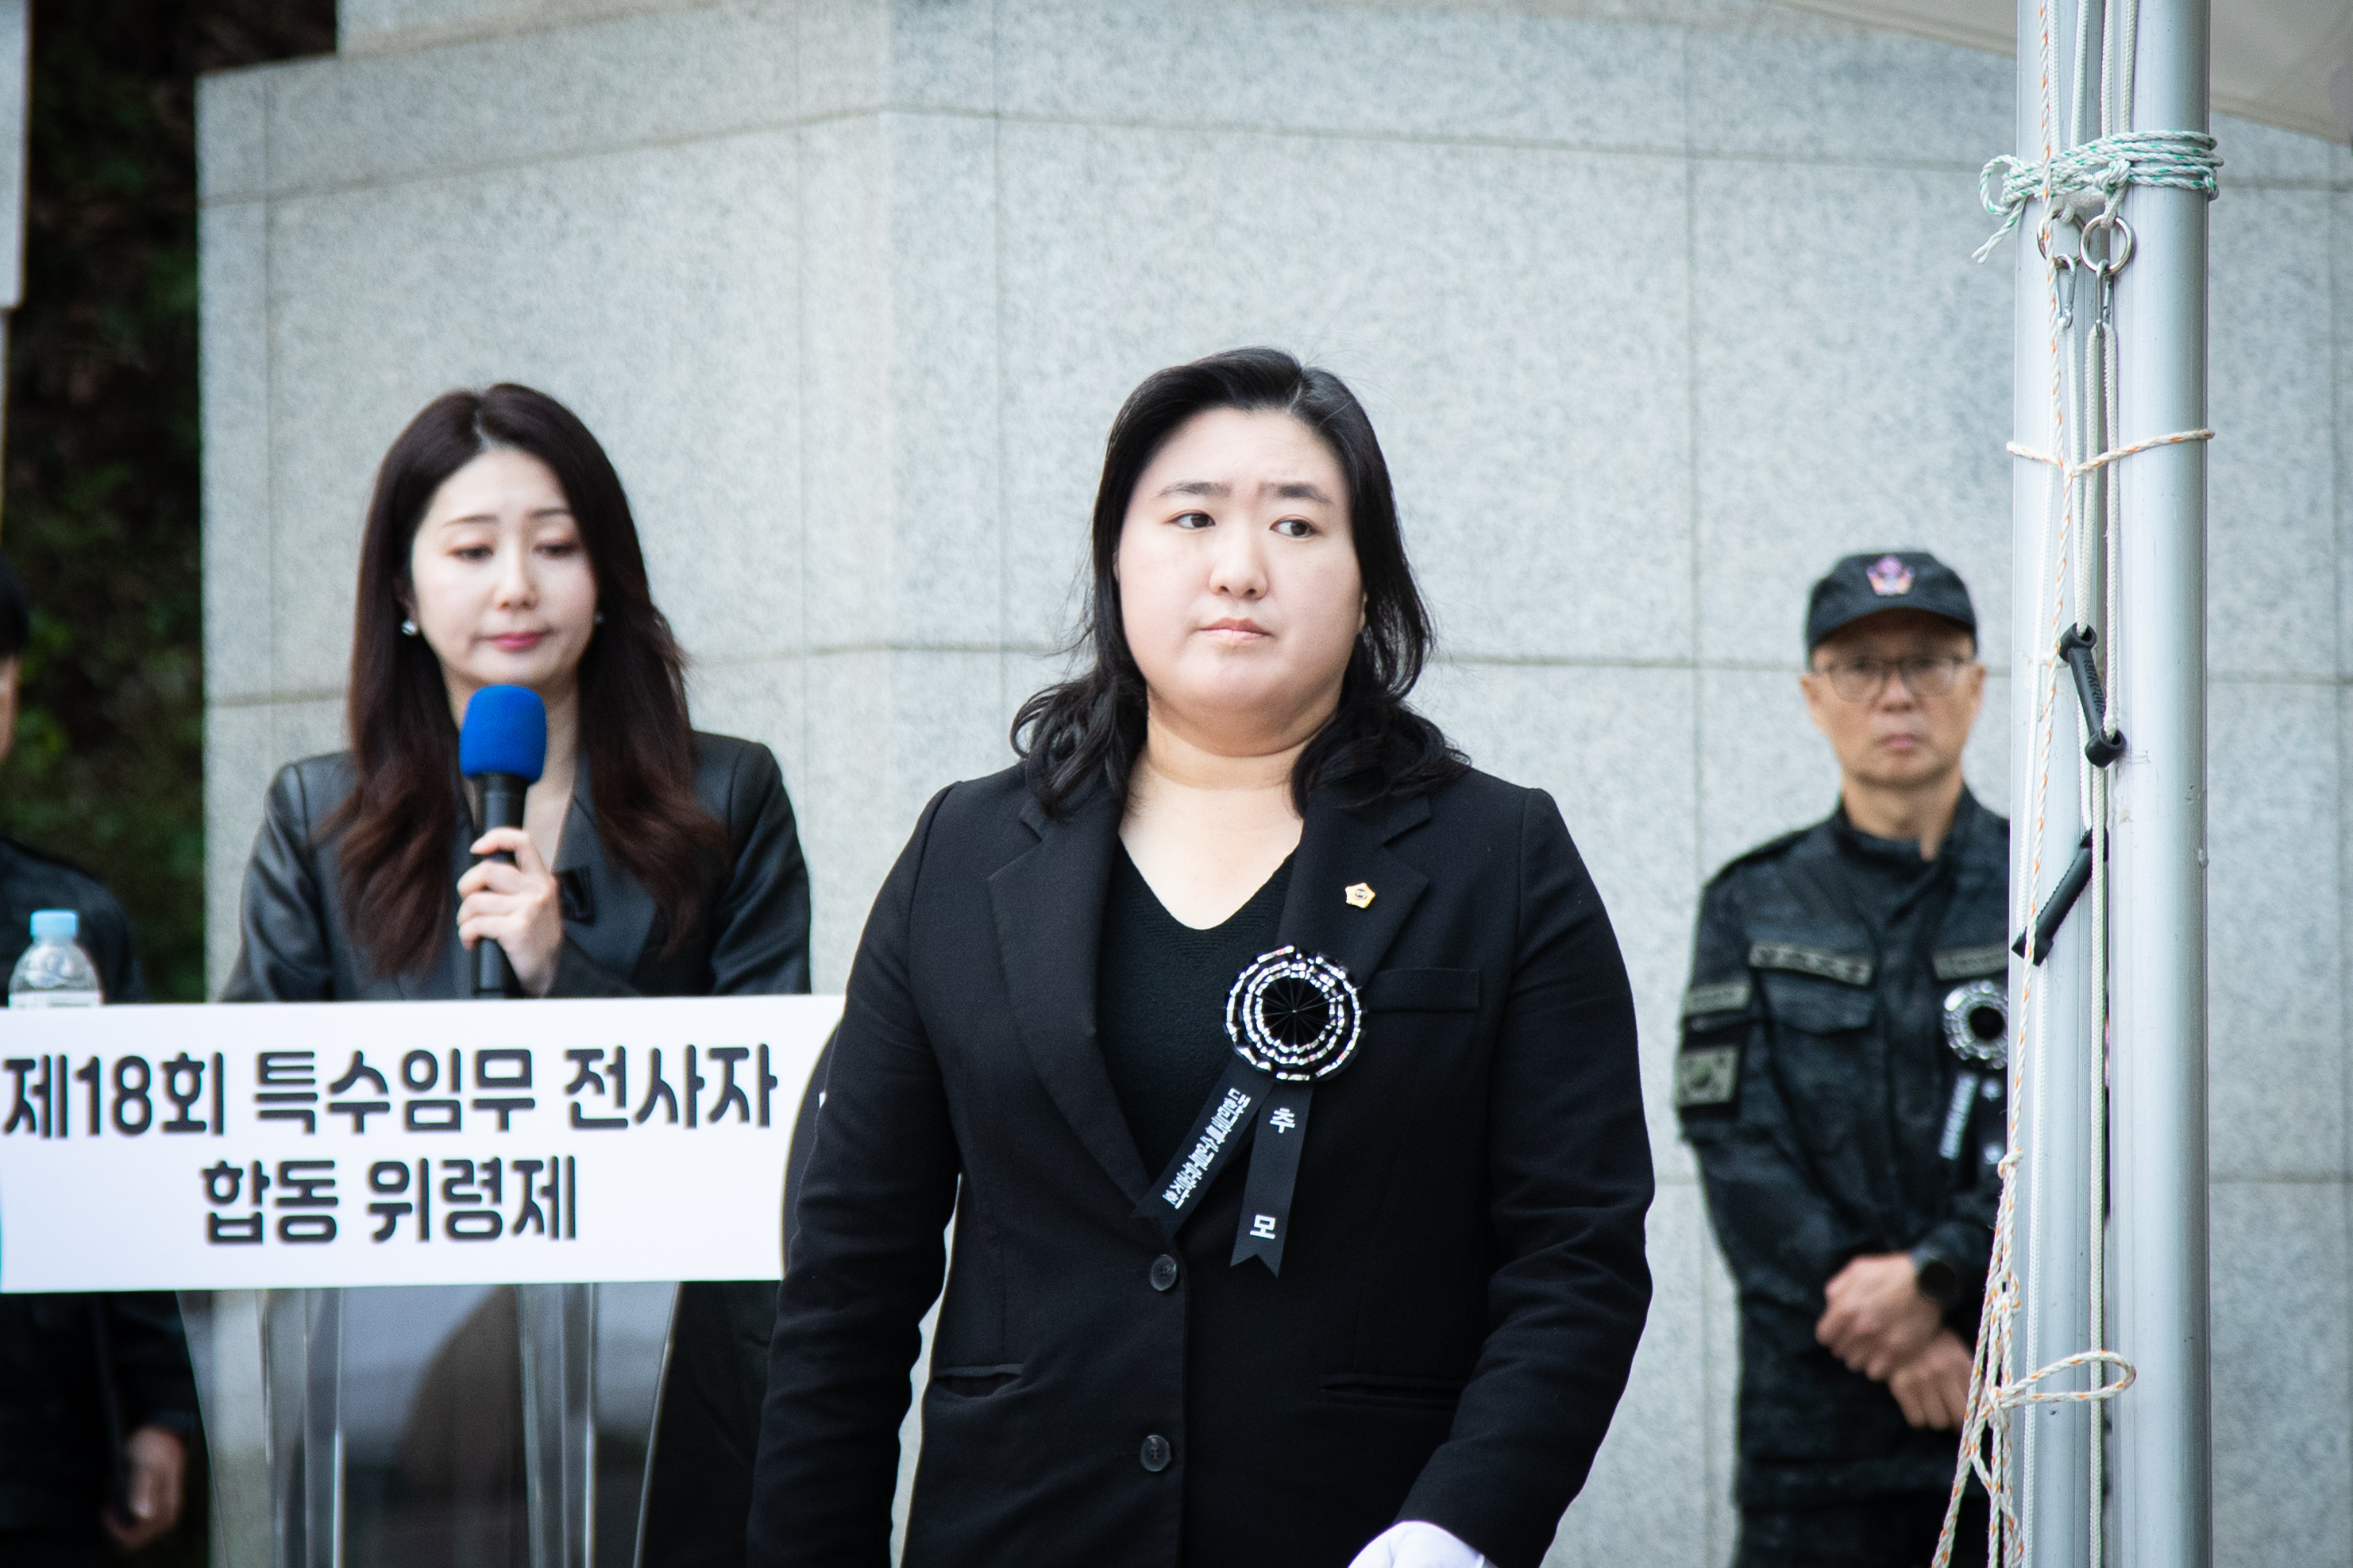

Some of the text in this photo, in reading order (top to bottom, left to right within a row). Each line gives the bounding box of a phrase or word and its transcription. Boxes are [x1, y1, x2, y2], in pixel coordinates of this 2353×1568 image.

[4, 1044, 777, 1138] 제18회 특수임무 전사자
[203, 1156, 576, 1244] 합동 위령제
